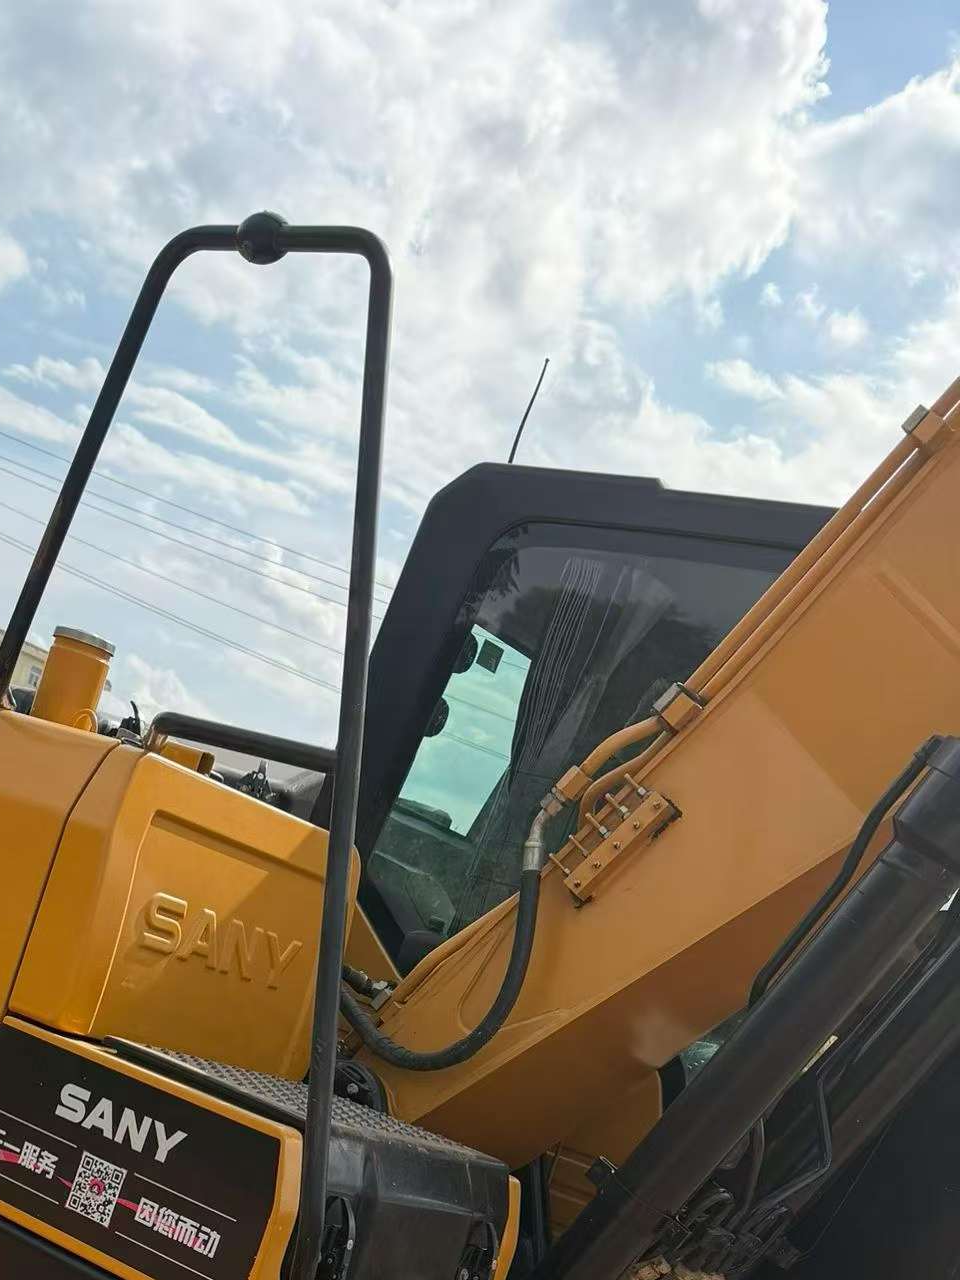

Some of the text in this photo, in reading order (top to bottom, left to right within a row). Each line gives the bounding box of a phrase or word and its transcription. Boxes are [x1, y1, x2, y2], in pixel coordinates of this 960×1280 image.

[140, 892, 303, 990] SANY
[54, 1083, 188, 1163] SANY
[134, 1197, 221, 1259] 因您而动
